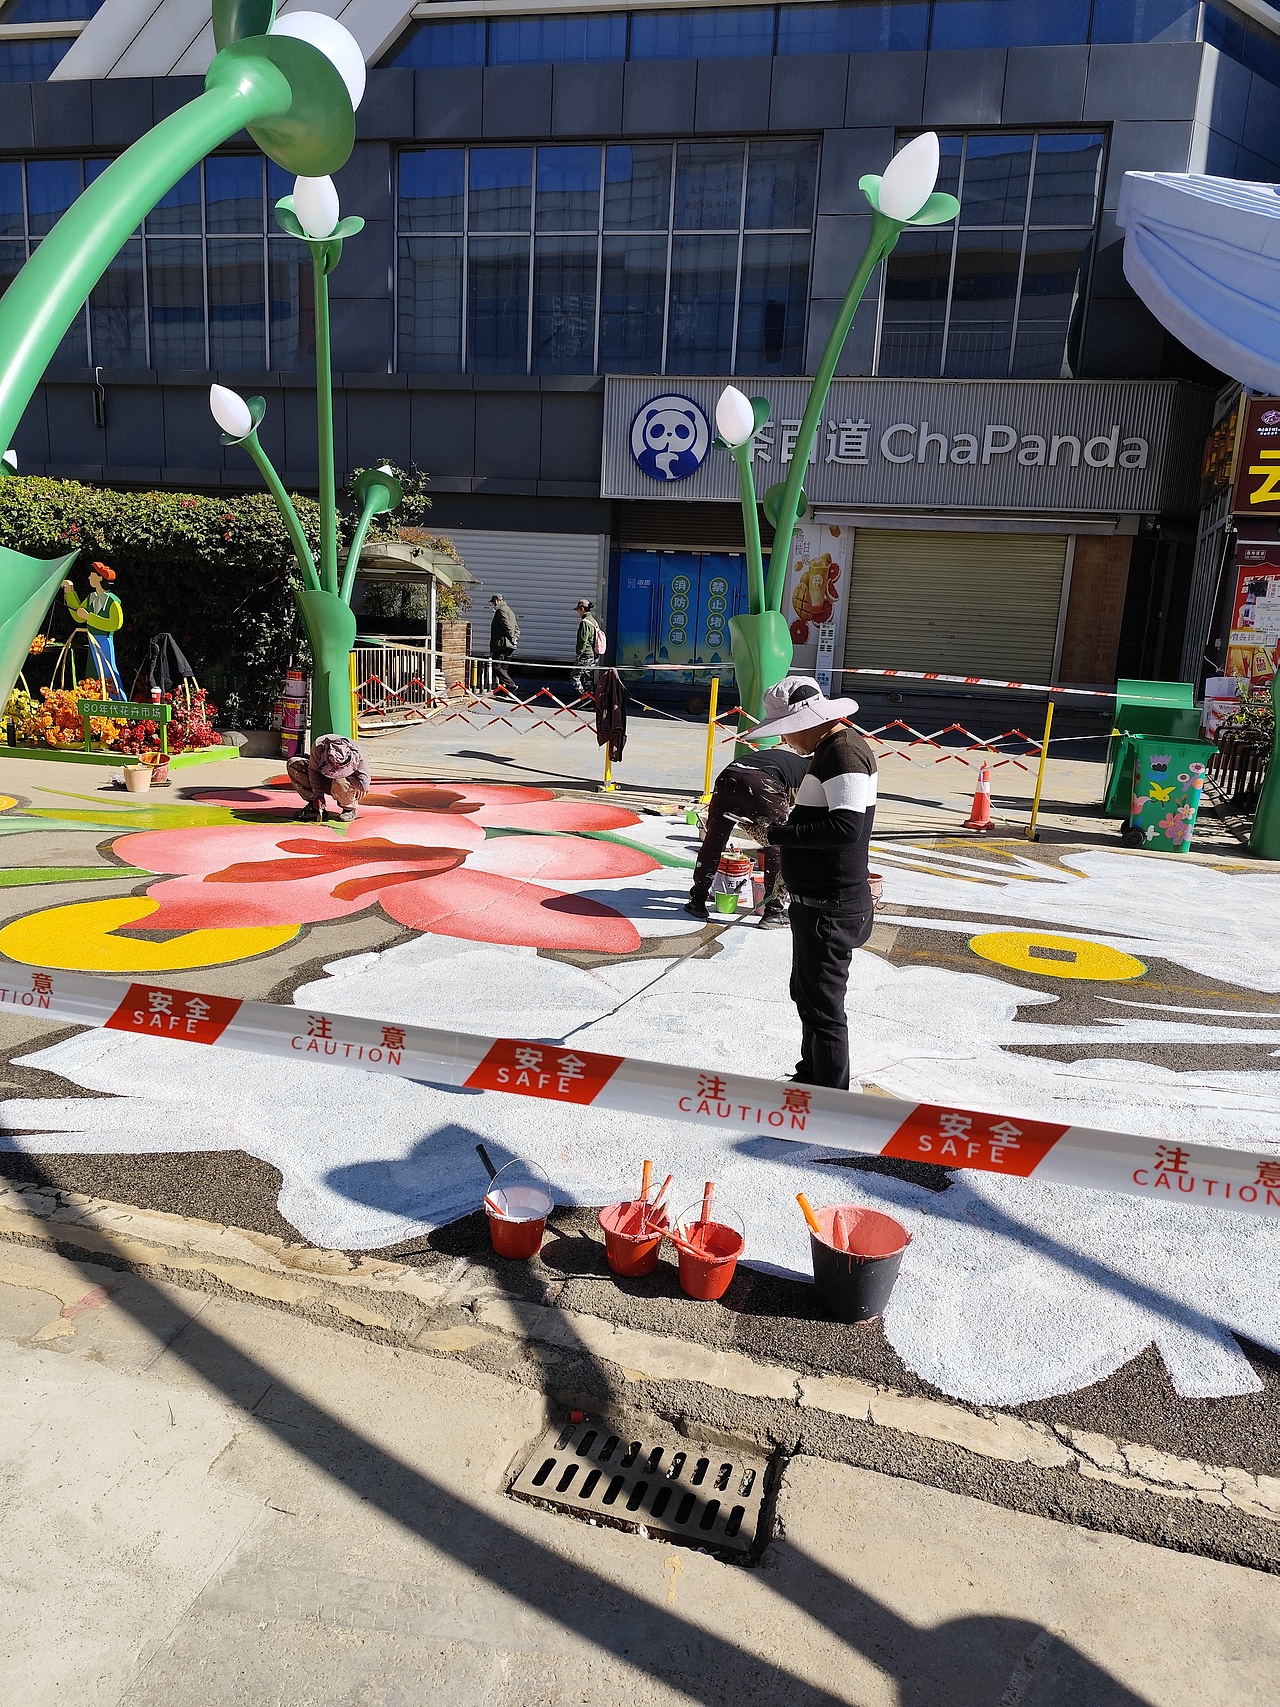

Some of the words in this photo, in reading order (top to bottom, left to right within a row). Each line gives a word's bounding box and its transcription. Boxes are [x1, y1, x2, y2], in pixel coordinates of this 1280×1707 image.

[880, 421, 1149, 469] ChaPanda
[671, 579, 687, 642] 消防通道
[708, 581, 725, 645] 禁止堵塞
[83, 703, 161, 718] 80年代花卉市场
[132, 1010, 197, 1034] SAFE
[147, 991, 211, 1021] 安全
[291, 1036, 402, 1066] CAUTION
[515, 1046, 587, 1080] 安全
[496, 1067, 571, 1094] SAFE
[678, 1096, 808, 1132] CAUTION
[938, 1112, 1023, 1149] 安全
[917, 1135, 1005, 1164] SAFE
[1132, 1169, 1280, 1207] CAUTION
